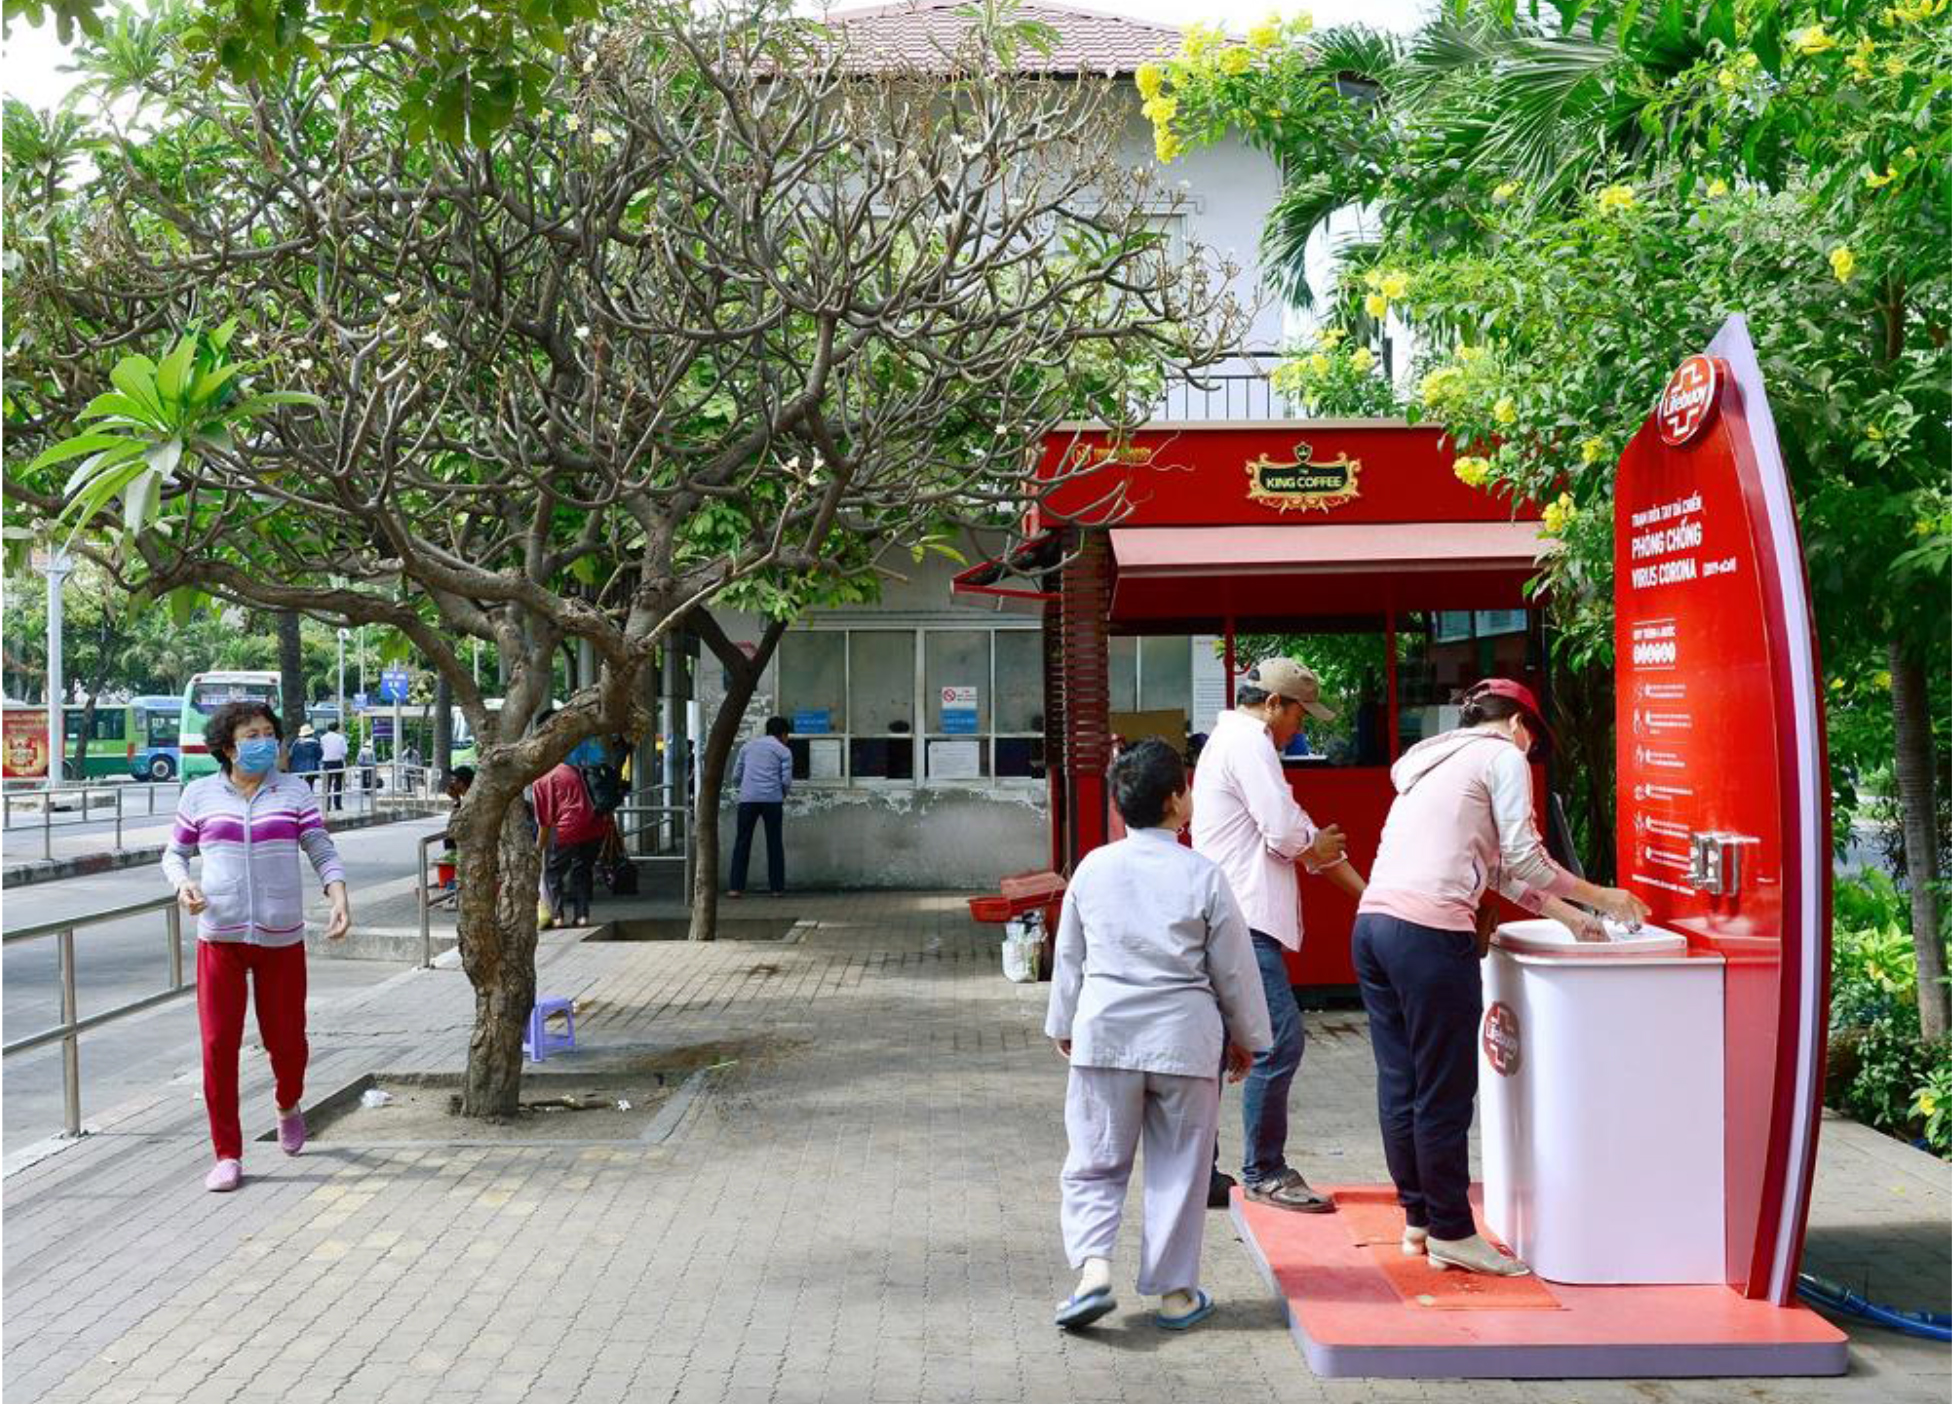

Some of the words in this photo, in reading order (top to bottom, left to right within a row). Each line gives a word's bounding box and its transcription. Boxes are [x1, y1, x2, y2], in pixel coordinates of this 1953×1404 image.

[1664, 386, 1707, 416] Lifebuoy
[1266, 477, 1296, 489] KING
[1297, 476, 1342, 488] COFFEE
[1632, 528, 1664, 560] PHÒNG
[1666, 516, 1703, 553] CHỐNG
[1632, 565, 1658, 589] VIRUS
[1659, 557, 1697, 586] CORONA
